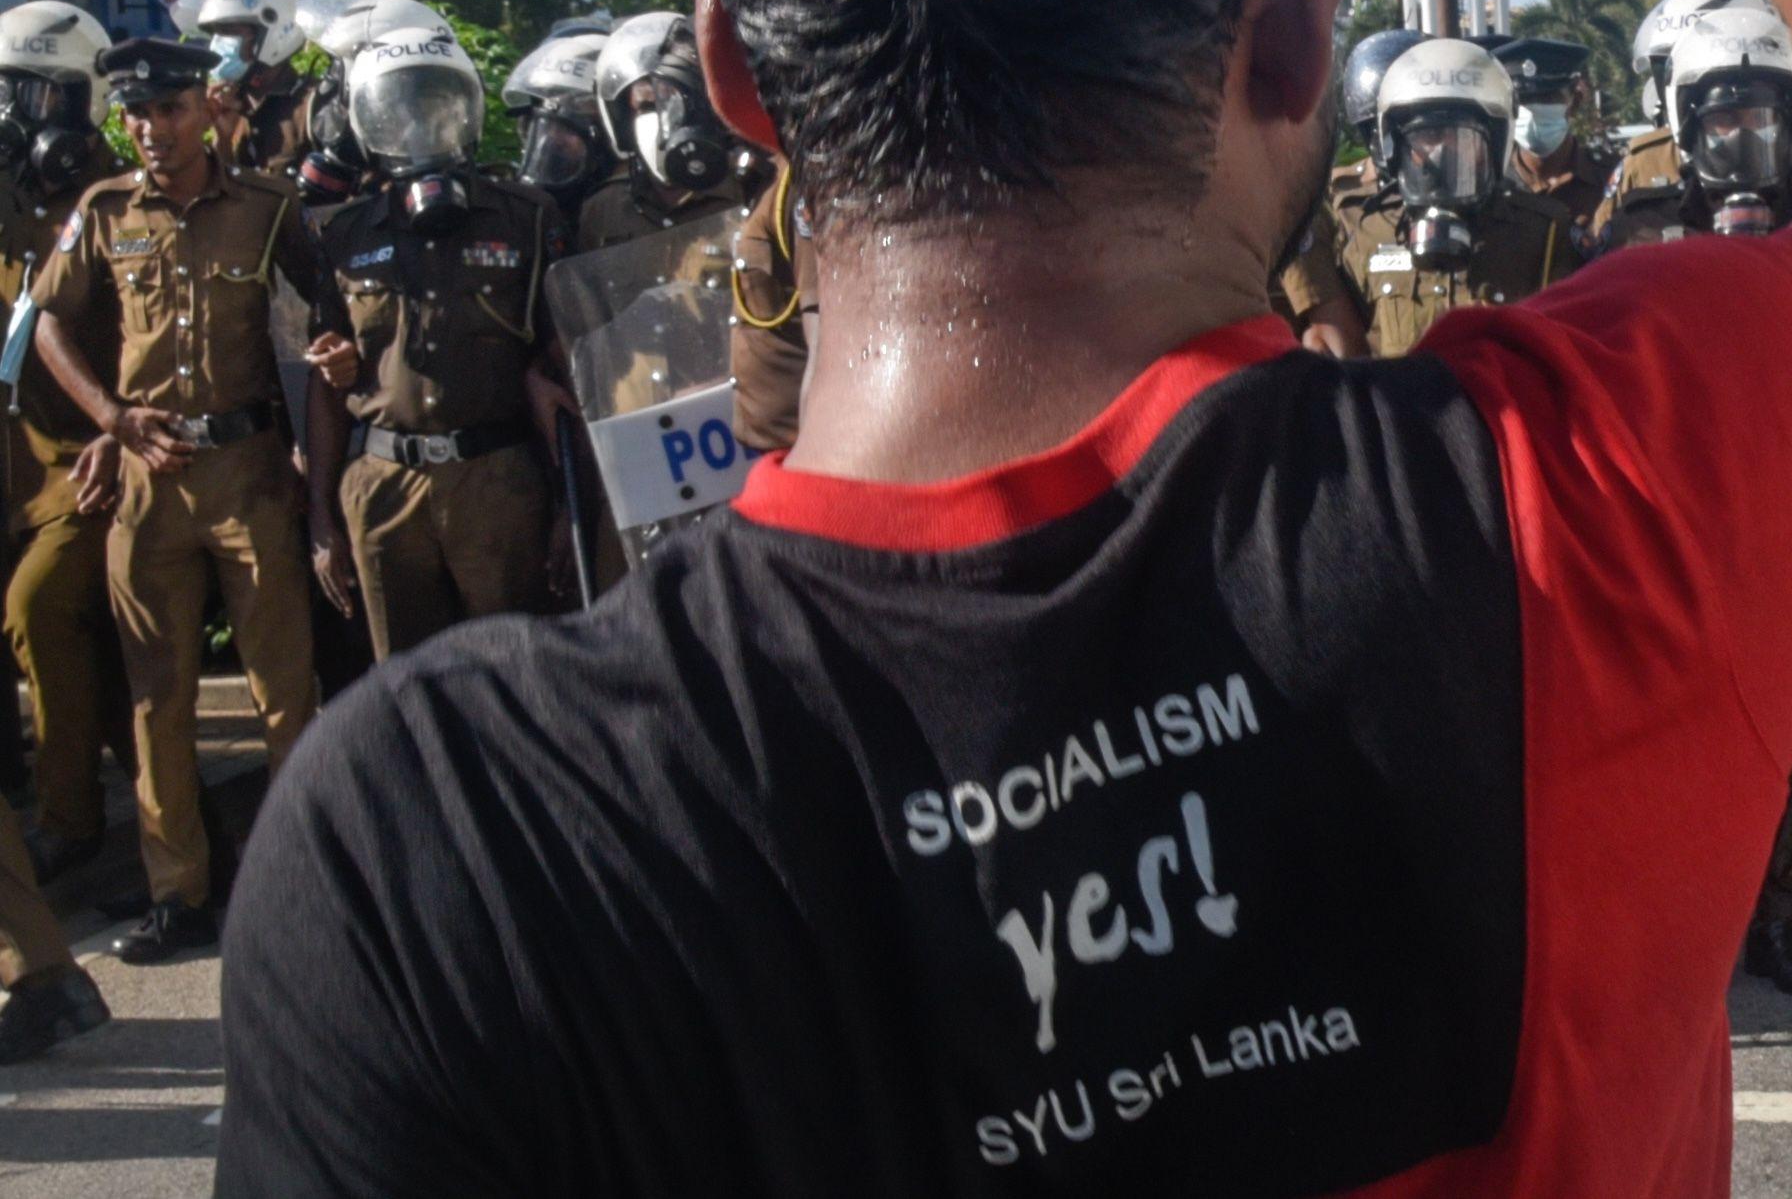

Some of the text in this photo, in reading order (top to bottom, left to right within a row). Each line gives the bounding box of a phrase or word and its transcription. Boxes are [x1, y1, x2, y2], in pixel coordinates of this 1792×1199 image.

[9, 36, 59, 55] LICE
[377, 39, 453, 63] POLICE
[661, 418, 760, 483] PO
[903, 673, 1260, 856] SOCIALISM
[975, 1005, 1361, 1166] SYU Sri Lanka
